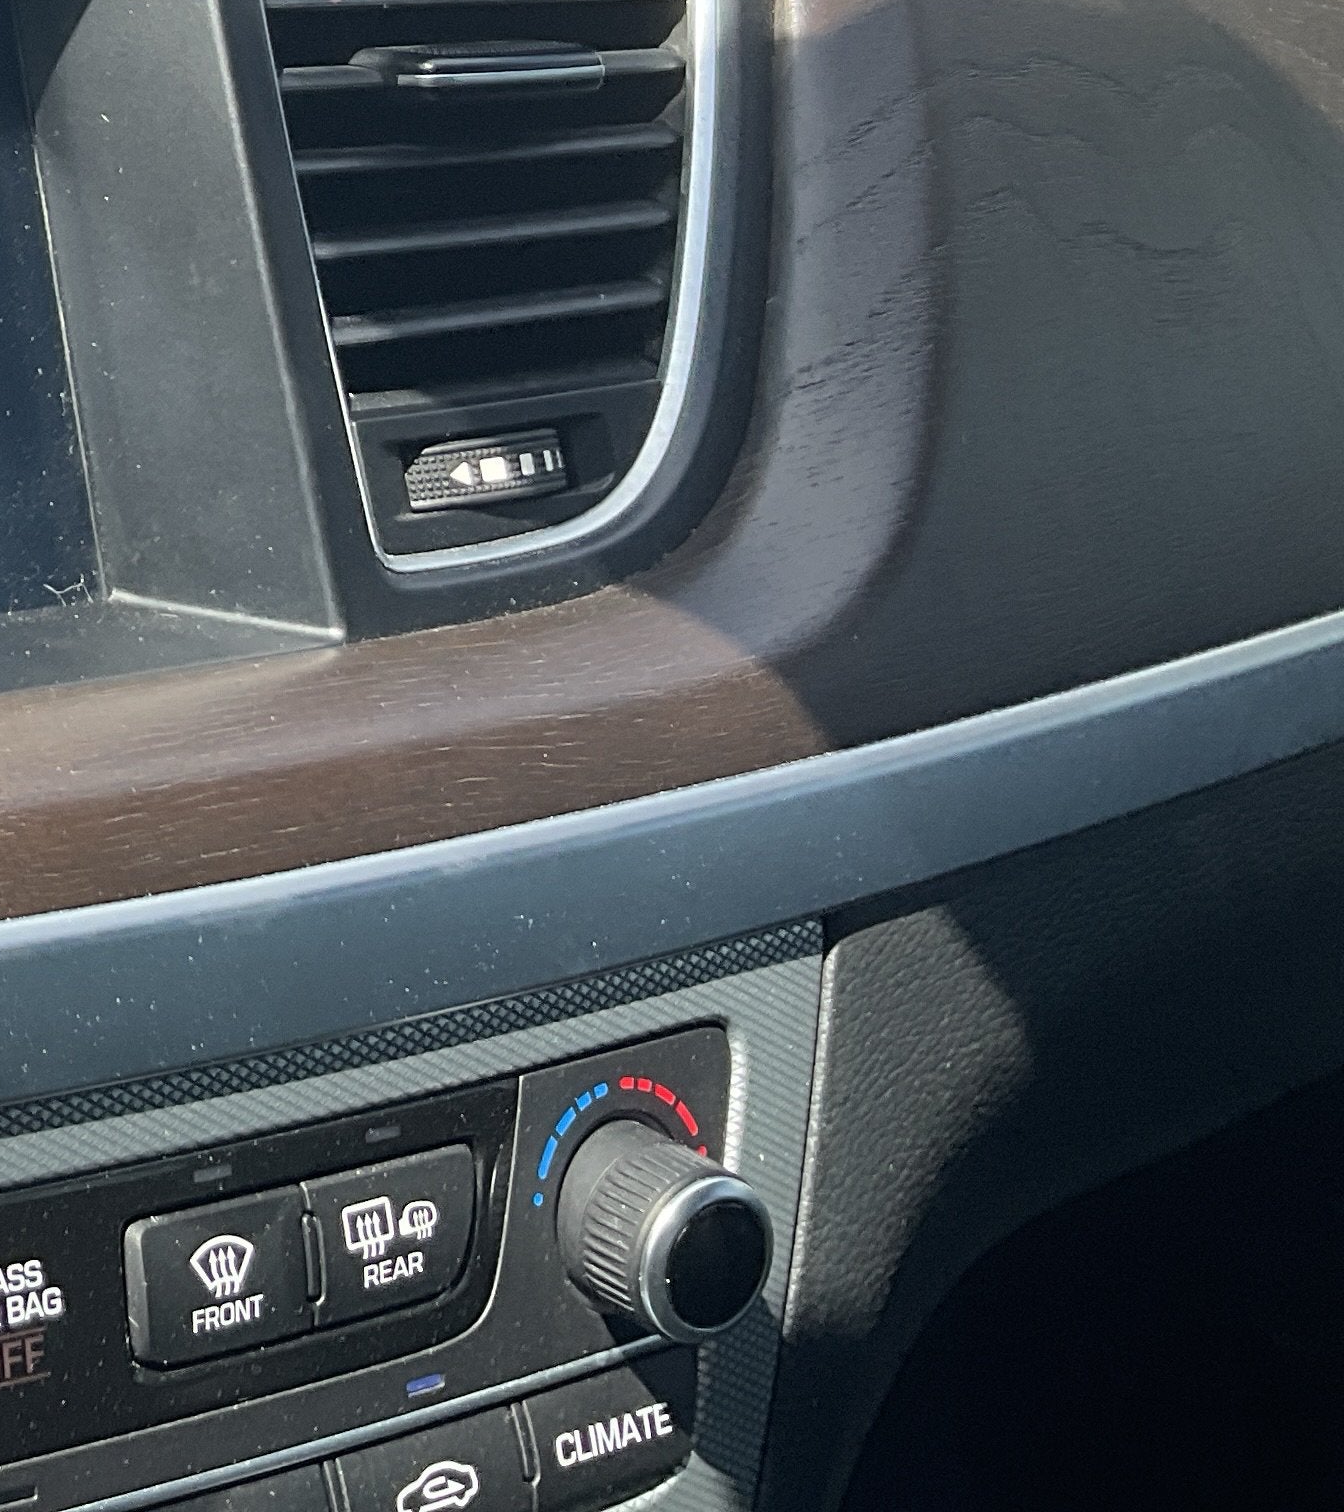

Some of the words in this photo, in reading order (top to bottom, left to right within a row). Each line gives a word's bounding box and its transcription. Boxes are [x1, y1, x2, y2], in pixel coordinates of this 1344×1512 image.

[364, 1252, 424, 1288] REAR
[7, 1287, 62, 1323] BAG
[192, 1296, 263, 1331] FRONT
[556, 1402, 673, 1466] CLIMATE
